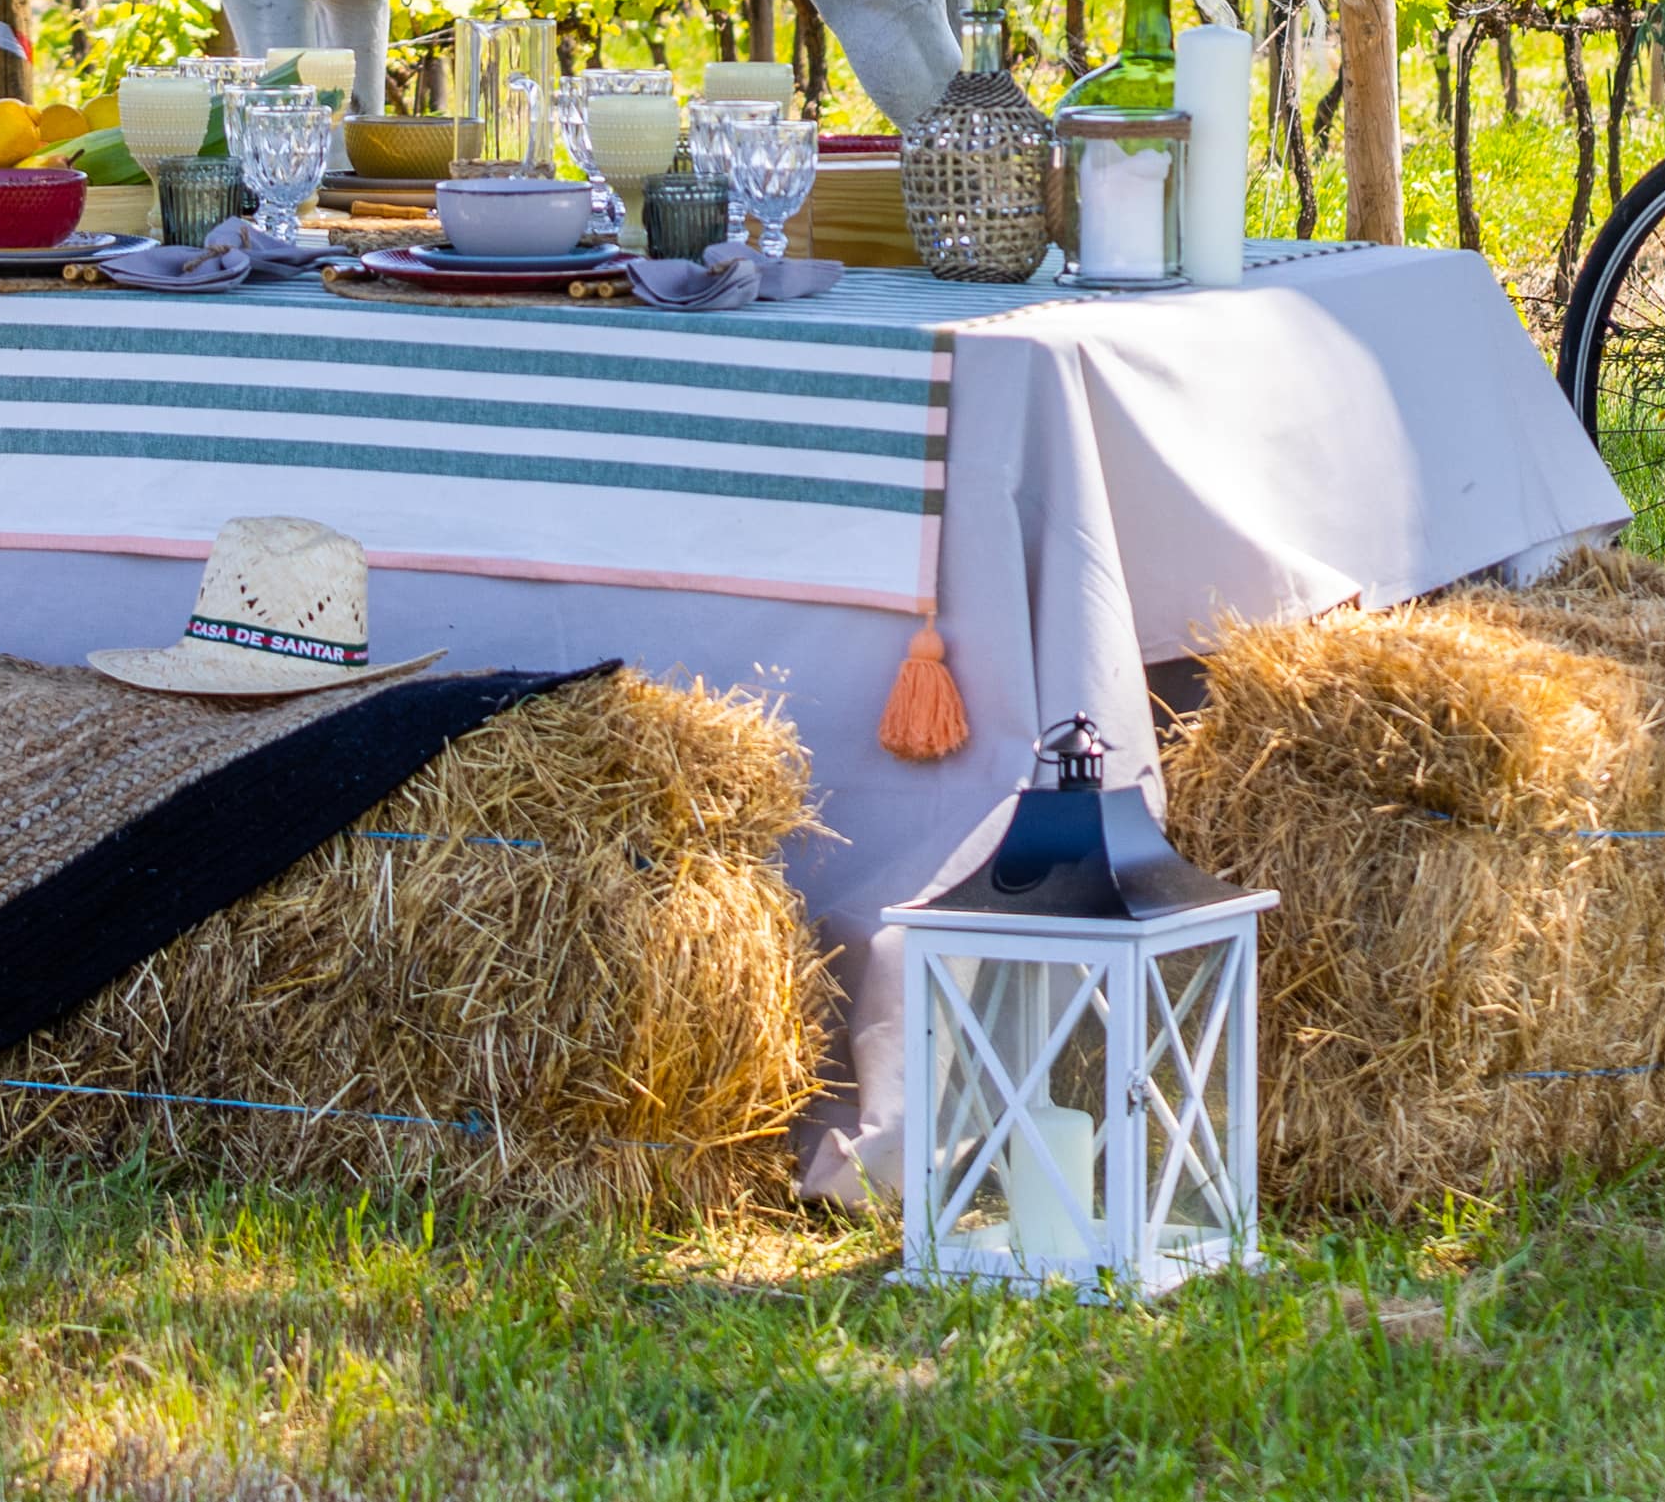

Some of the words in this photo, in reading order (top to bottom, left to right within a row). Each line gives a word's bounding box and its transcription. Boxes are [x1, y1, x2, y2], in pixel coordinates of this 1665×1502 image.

[192, 621, 228, 639] CASA
[235, 628, 265, 647] DE
[270, 636, 345, 662] SANTAR
